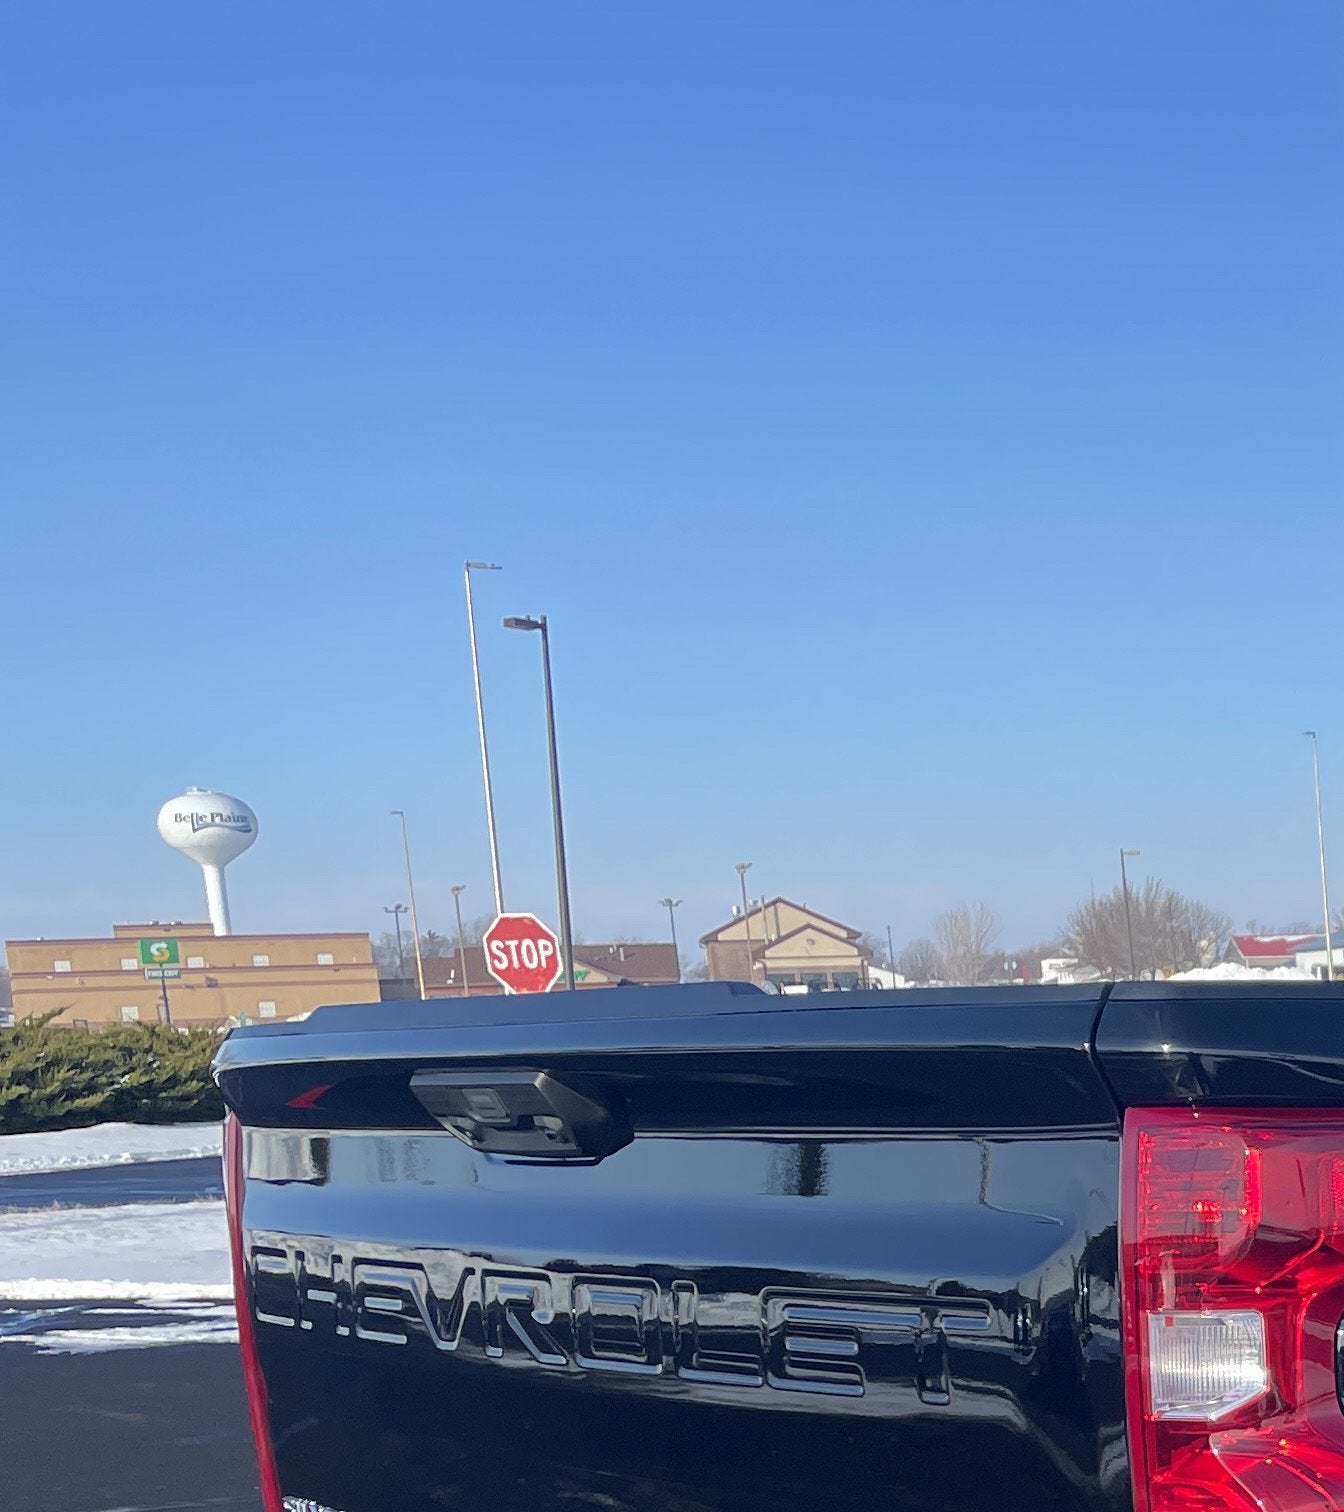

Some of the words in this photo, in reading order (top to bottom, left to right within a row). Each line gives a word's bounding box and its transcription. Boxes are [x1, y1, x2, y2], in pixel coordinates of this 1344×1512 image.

[174, 813, 208, 834] Belle
[490, 938, 554, 970] STOP
[249, 1243, 994, 1405] CHEVROLET
